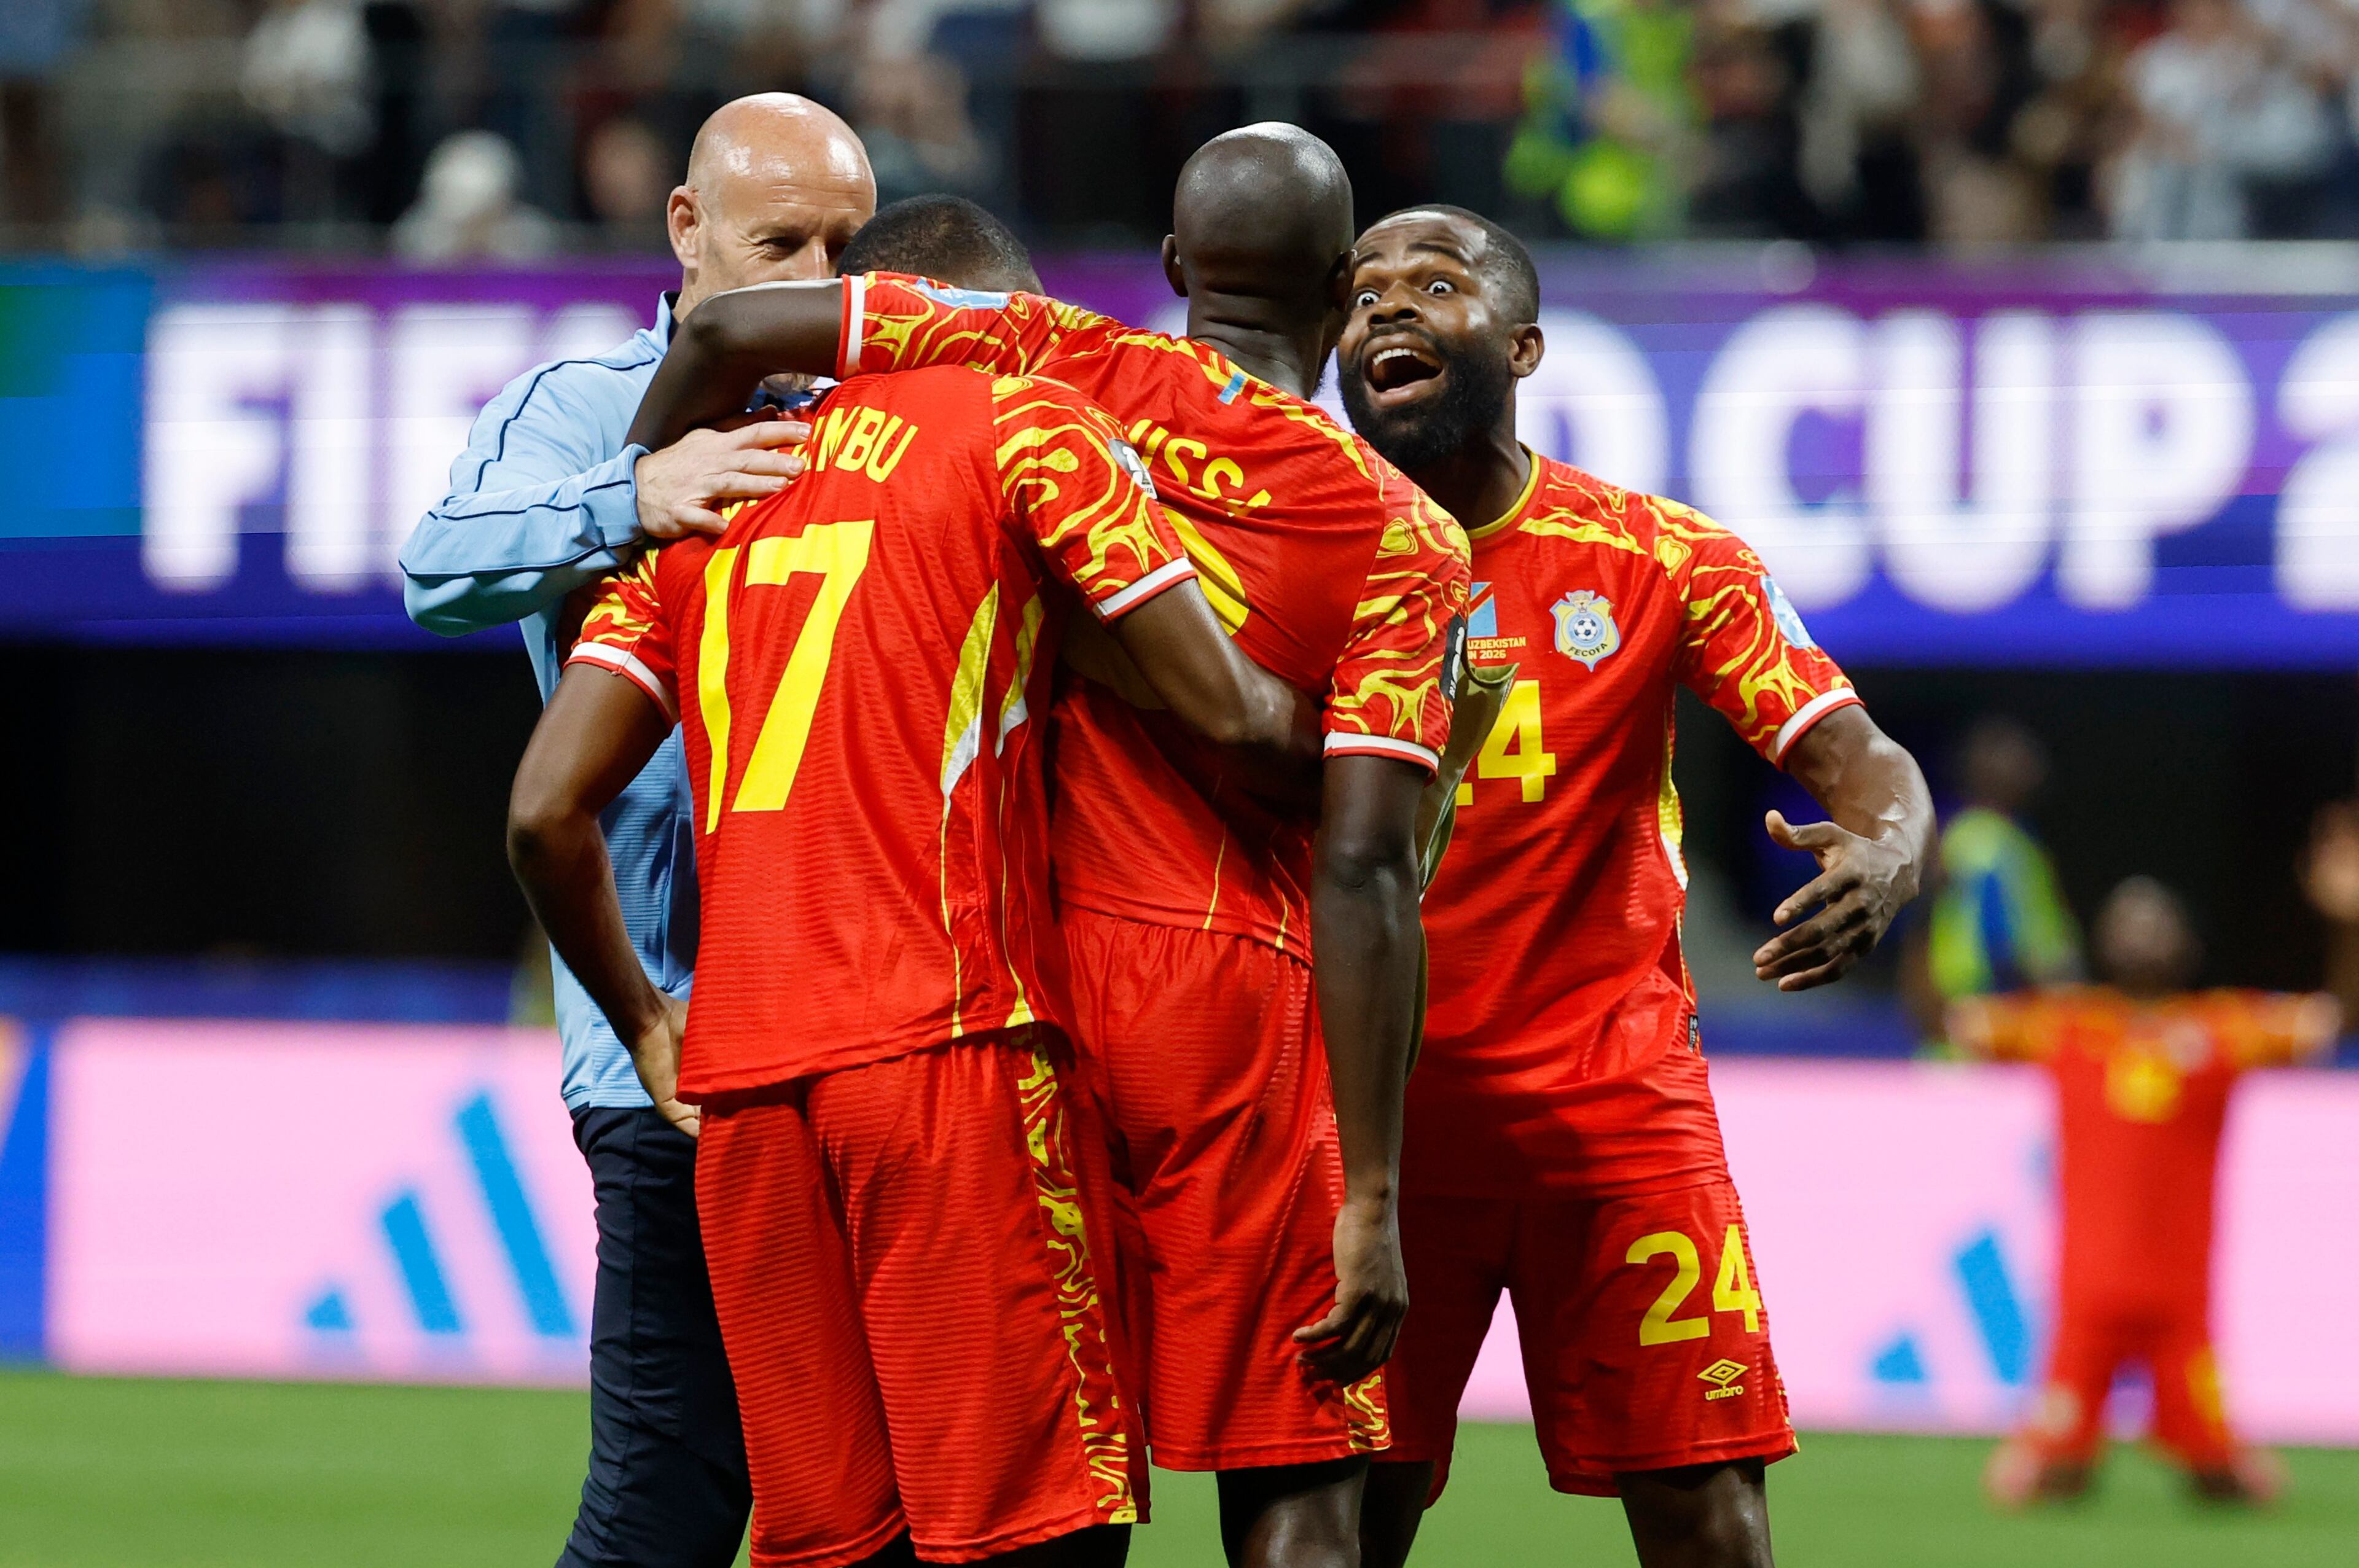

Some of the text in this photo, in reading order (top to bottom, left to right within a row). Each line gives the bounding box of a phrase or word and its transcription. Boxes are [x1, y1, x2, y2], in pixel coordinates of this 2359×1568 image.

[141, 302, 642, 593] FIF
[1689, 301, 2256, 613] CUP
[697, 520, 875, 835] 17
[1467, 636, 1527, 650] UZBEKISTAN
[1479, 649, 1506, 660] 2026
[1568, 642, 1608, 657] FECOFA
[1456, 679, 1556, 806] 4
[1625, 1223, 1762, 1346] 24
[1705, 1385, 1744, 1402] umbro
